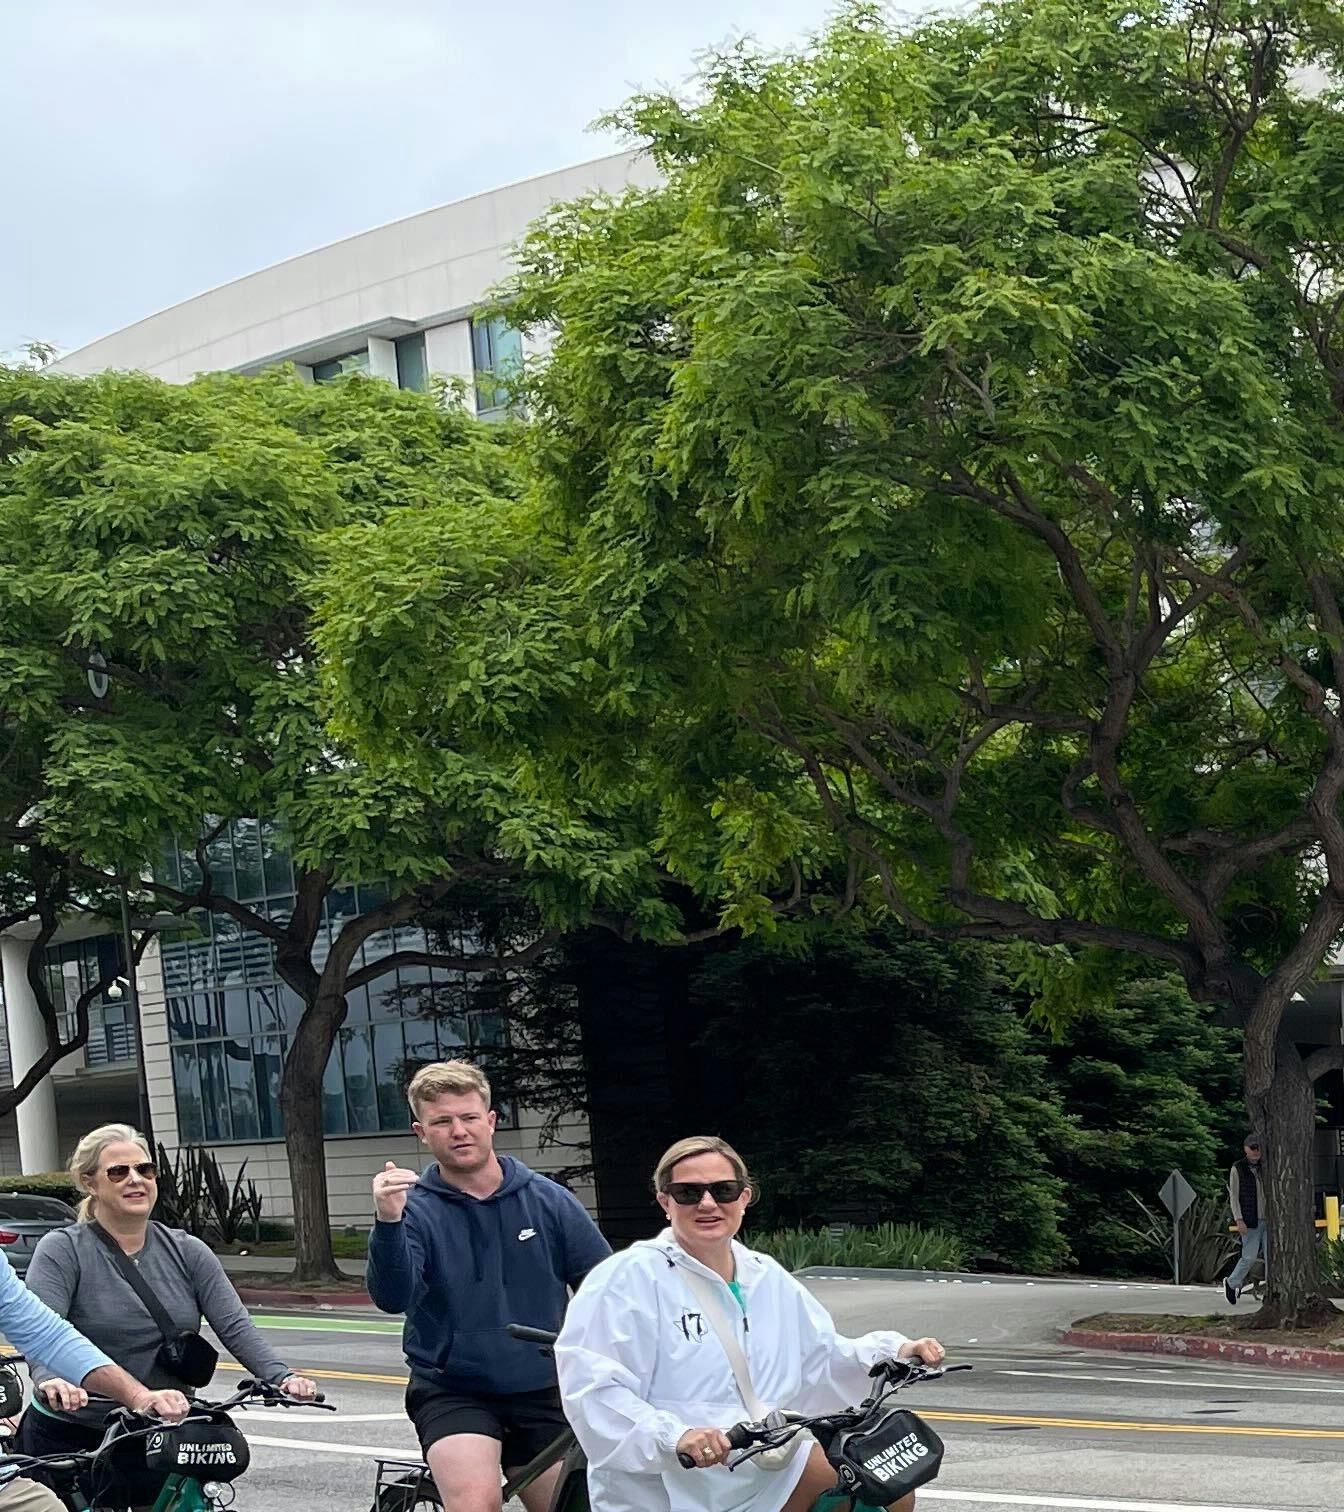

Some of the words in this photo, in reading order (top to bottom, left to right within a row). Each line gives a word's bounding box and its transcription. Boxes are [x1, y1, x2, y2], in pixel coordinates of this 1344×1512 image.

[682, 1313, 701, 1342] 17
[177, 1452, 237, 1465] BIKING
[179, 1443, 232, 1452] UNLIMITED
[864, 1432, 918, 1470] UNLIMITED
[873, 1442, 929, 1482] BIKING
